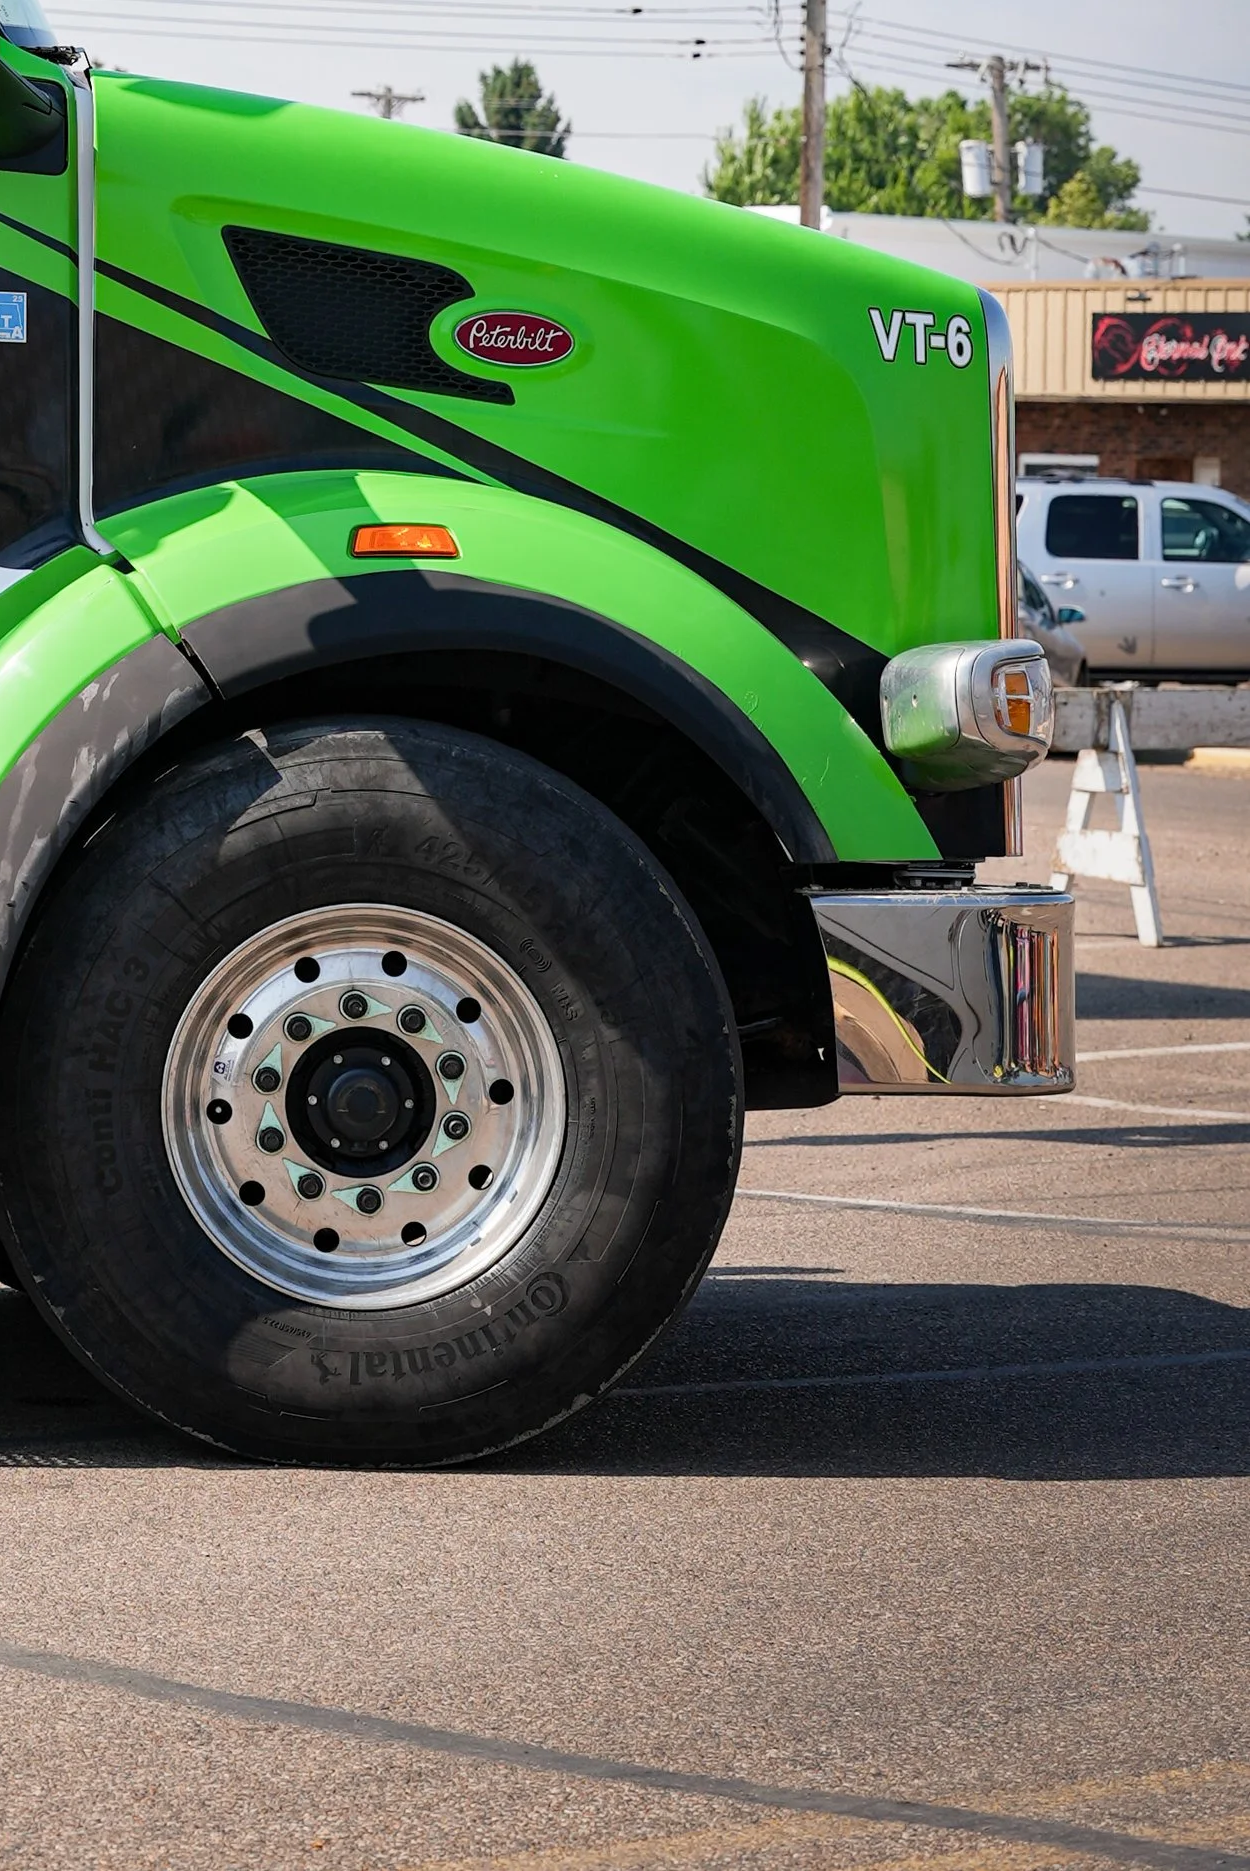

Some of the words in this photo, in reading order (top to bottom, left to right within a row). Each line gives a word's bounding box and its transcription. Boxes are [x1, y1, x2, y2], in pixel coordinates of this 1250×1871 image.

[469, 320, 563, 351] Peterbilt
[868, 308, 973, 368] VT-6
[89, 990, 134, 1072] HAC
[123, 956, 149, 982] 3
[349, 1271, 569, 1386] Continental
